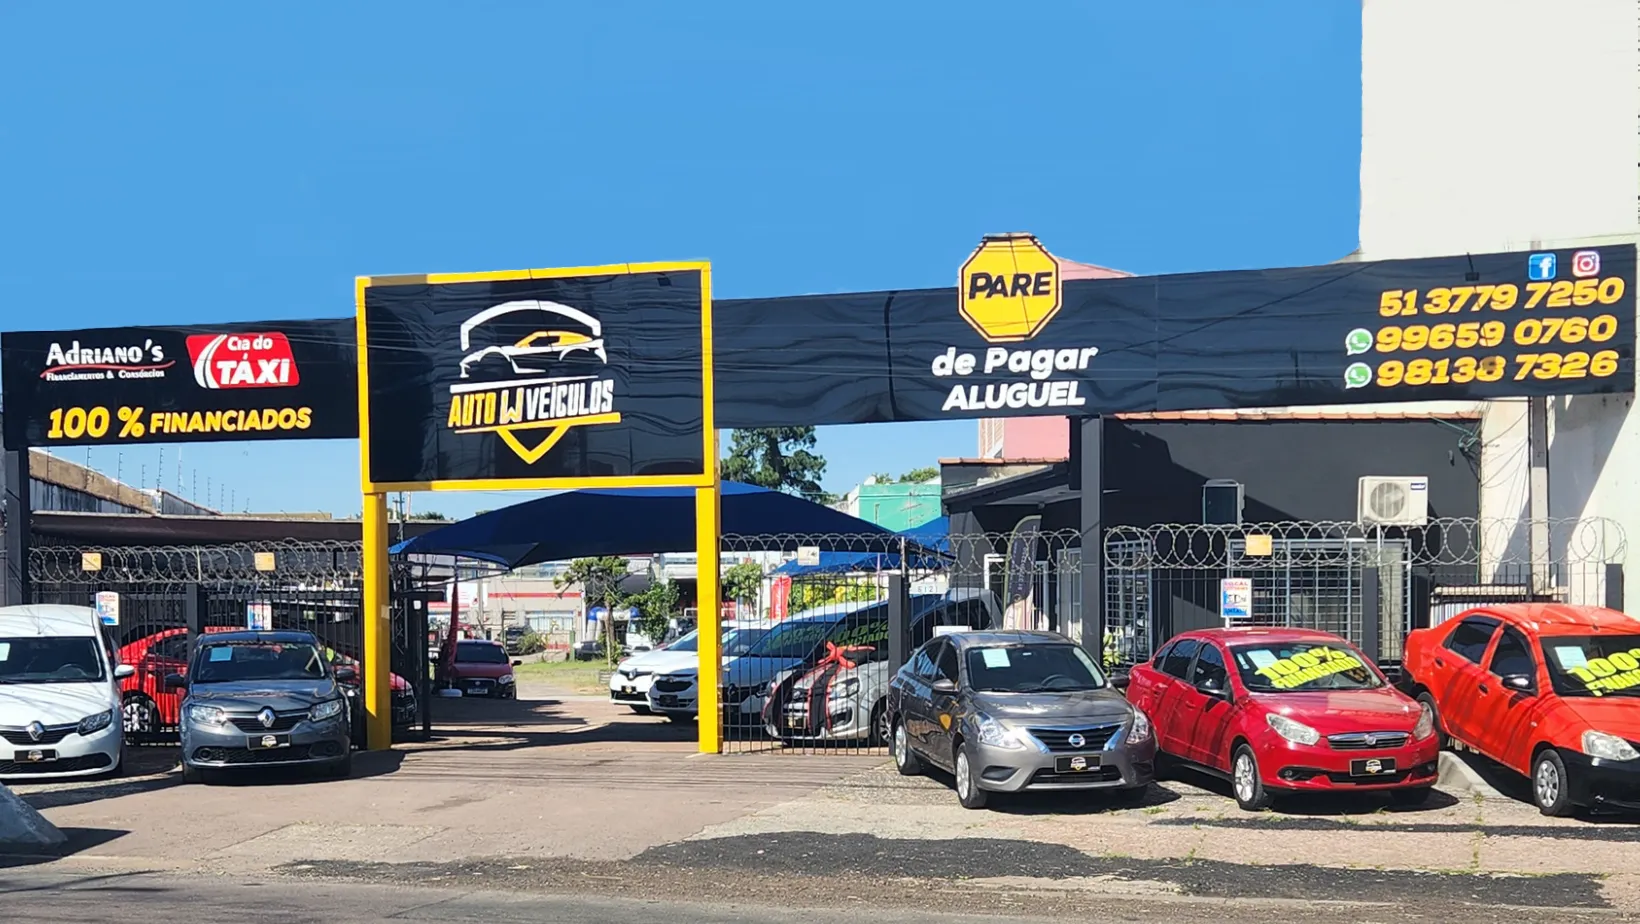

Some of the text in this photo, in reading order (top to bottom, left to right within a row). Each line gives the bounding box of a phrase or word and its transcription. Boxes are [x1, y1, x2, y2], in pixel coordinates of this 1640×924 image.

[968, 271, 1053, 300] PARE
[1379, 277, 1625, 317] 51 3779 7250
[227, 335, 273, 351] Cia do
[1375, 315, 1618, 352] 99659 0760
[106, 370, 114, 379] &
[217, 352, 291, 385] TÁXI
[932, 346, 1098, 380] de Pagar
[1376, 350, 1619, 387] 98138 7326
[448, 392, 496, 427] AUTO
[526, 379, 614, 420] VEÍCULOS
[942, 380, 1086, 411] ALUGUEL
[48, 407, 312, 438] 100 % FINANCIADOS
[1255, 646, 1347, 681] 100%
